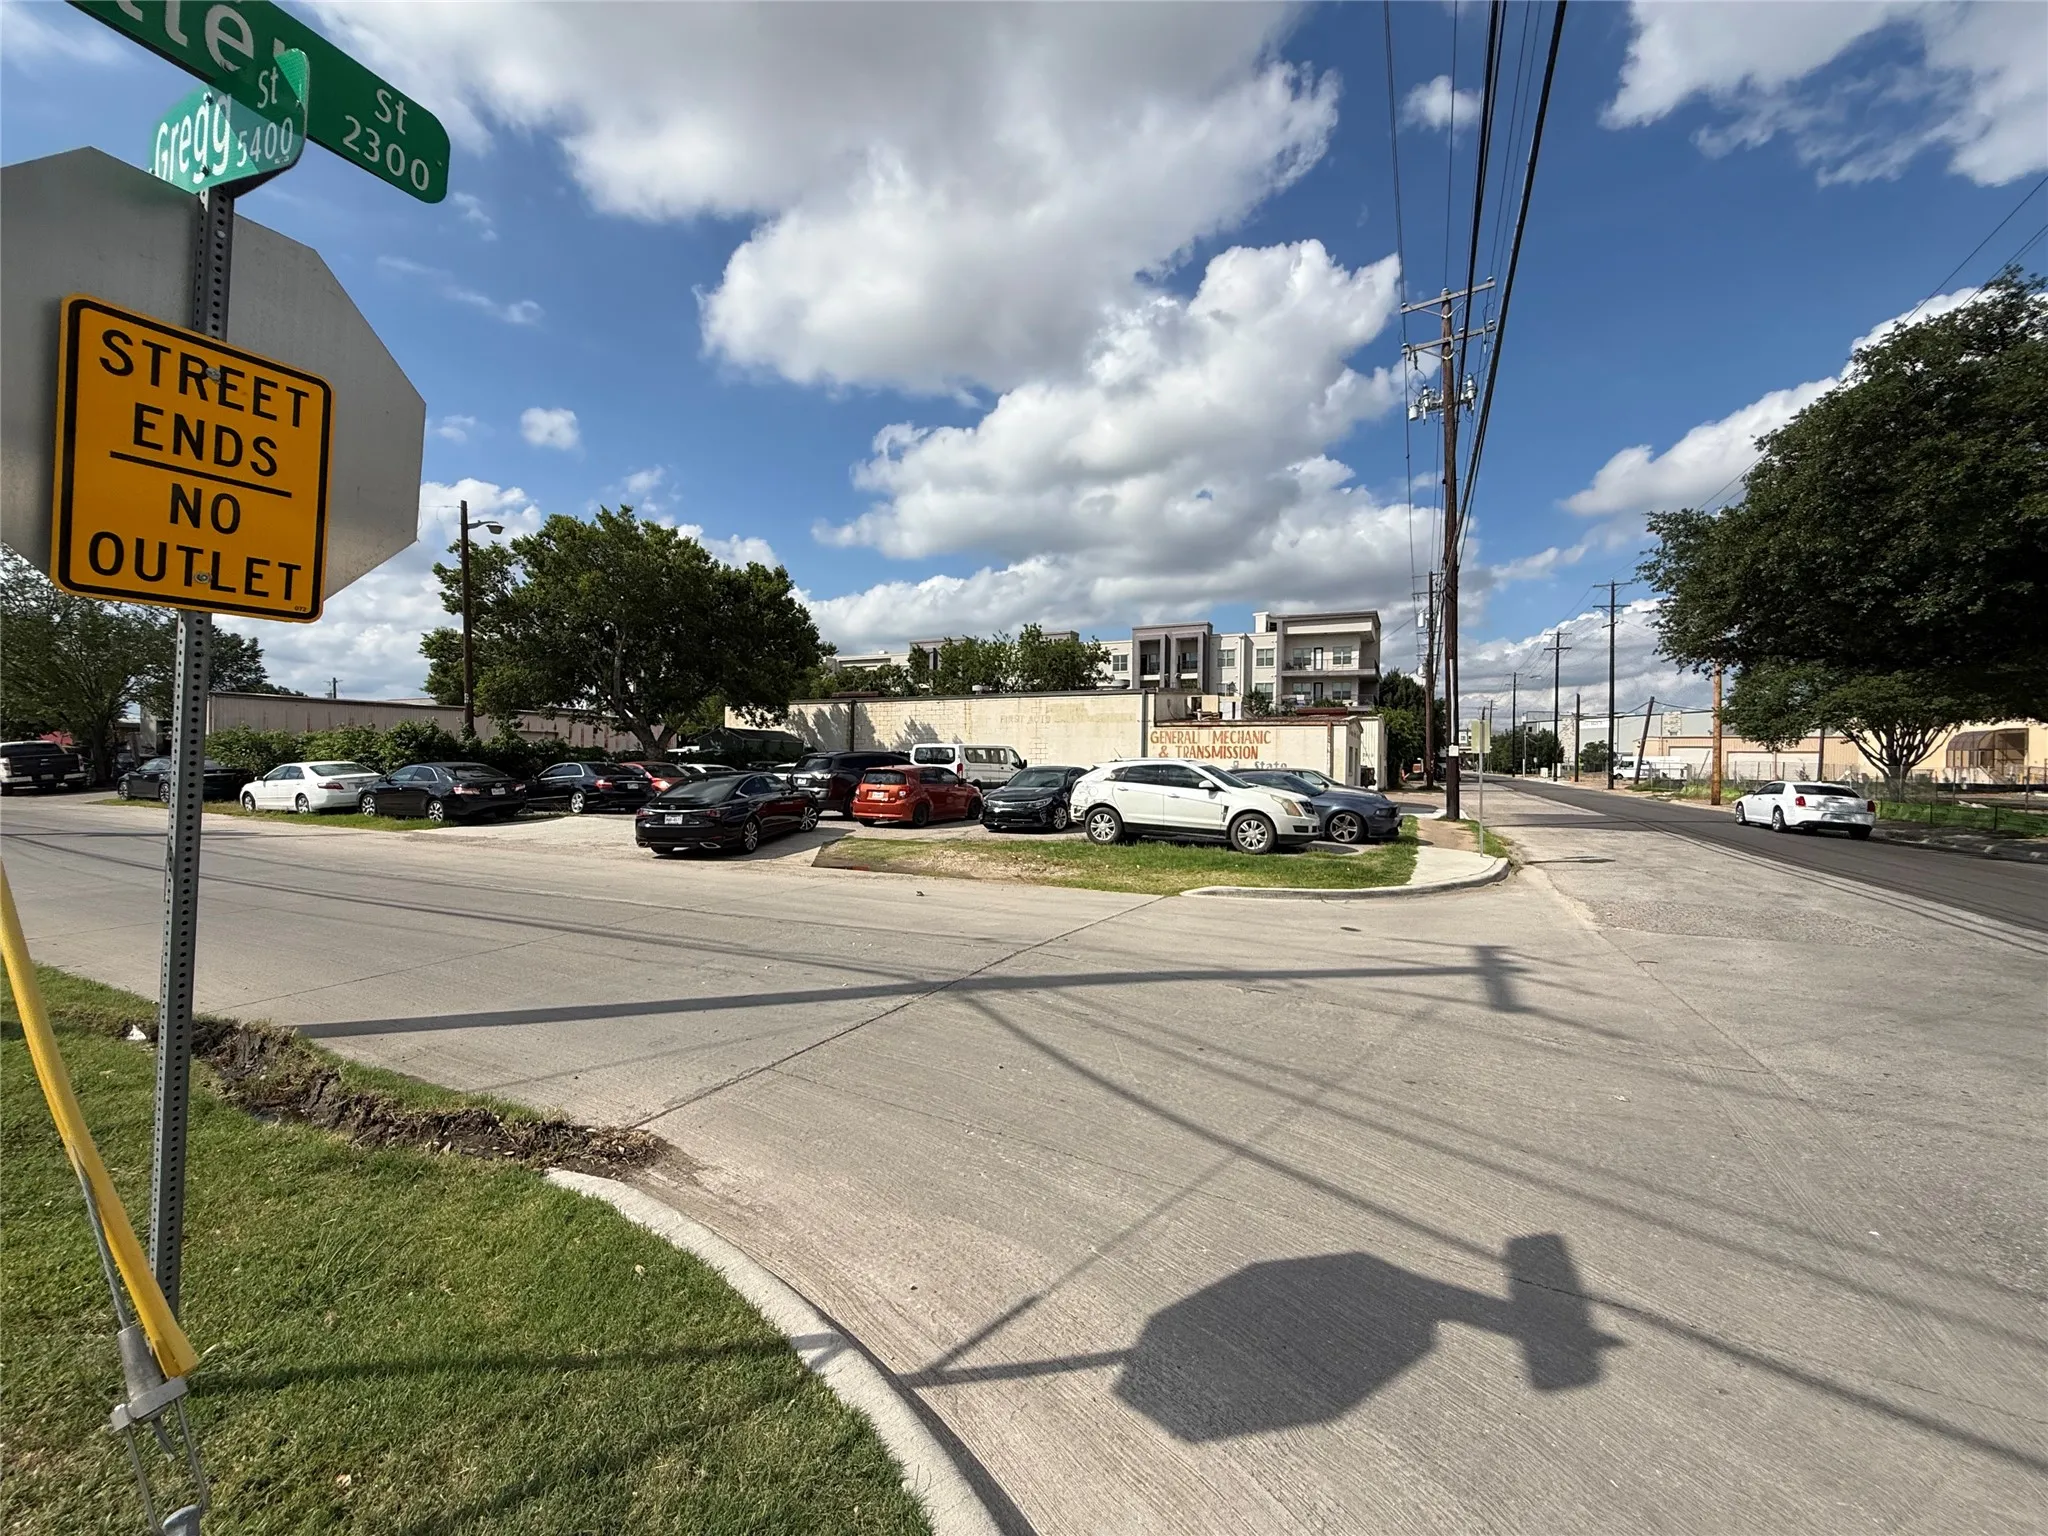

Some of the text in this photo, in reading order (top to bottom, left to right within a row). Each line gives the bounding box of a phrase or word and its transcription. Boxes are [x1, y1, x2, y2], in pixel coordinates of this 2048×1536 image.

[155, 66, 279, 184] Gregg St
[237, 117, 293, 167] 5400
[374, 88, 407, 136] St
[342, 115, 429, 191] 2300
[100, 329, 309, 428] STREET
[133, 402, 278, 477] ENDS
[169, 483, 241, 535] NO
[88, 531, 302, 601] OUTLET
[1150, 730, 1272, 745] GENERAL MECHANIC
[1158, 745, 1259, 759] & TRANSMISSION
